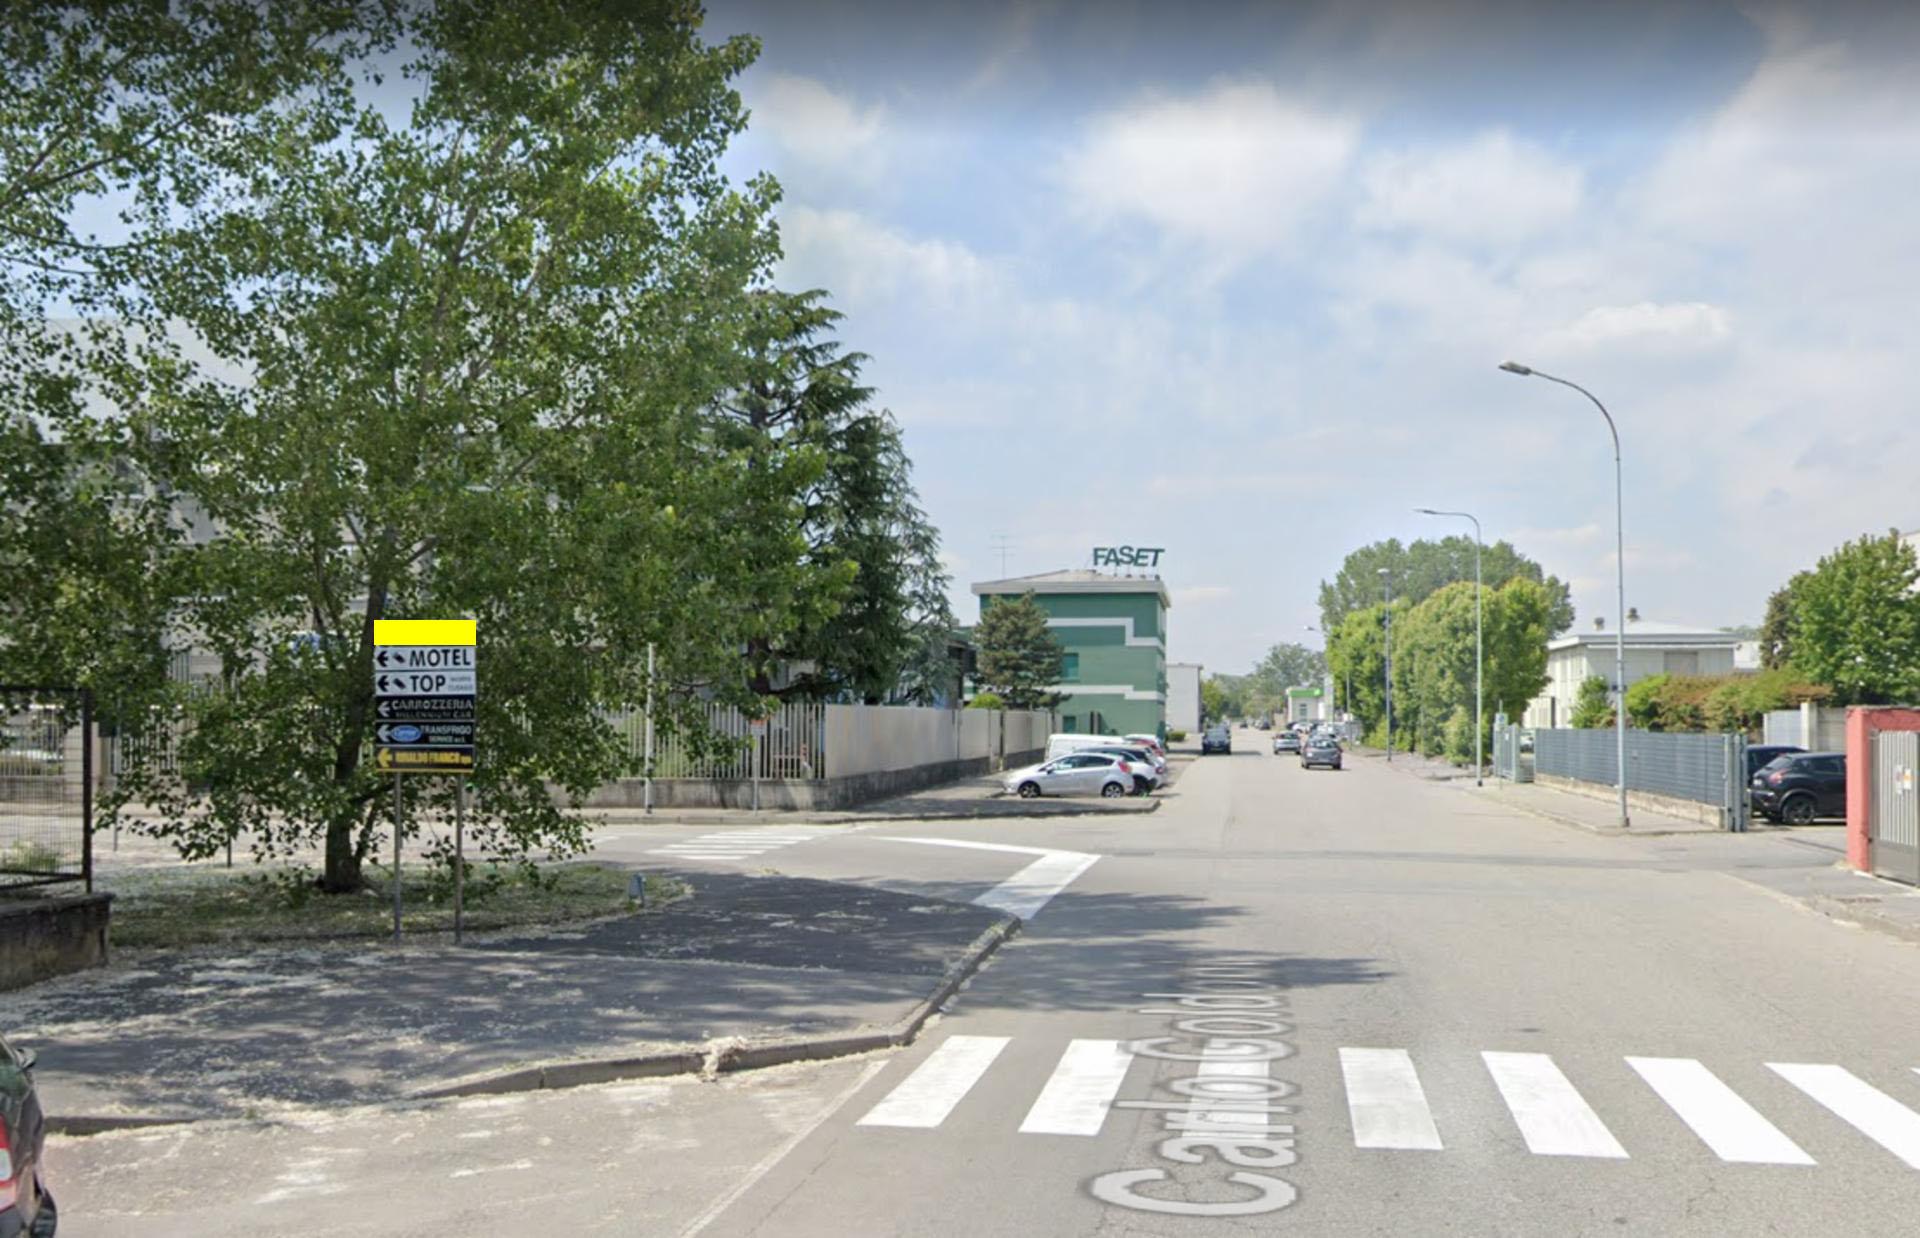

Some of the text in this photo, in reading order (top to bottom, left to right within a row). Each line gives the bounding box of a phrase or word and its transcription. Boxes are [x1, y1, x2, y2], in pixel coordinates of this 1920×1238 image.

[1093, 545, 1165, 567] FASET
[410, 649, 471, 667] MOTEL
[410, 675, 446, 692] TOP
[392, 700, 473, 710] CARROZZERIA
